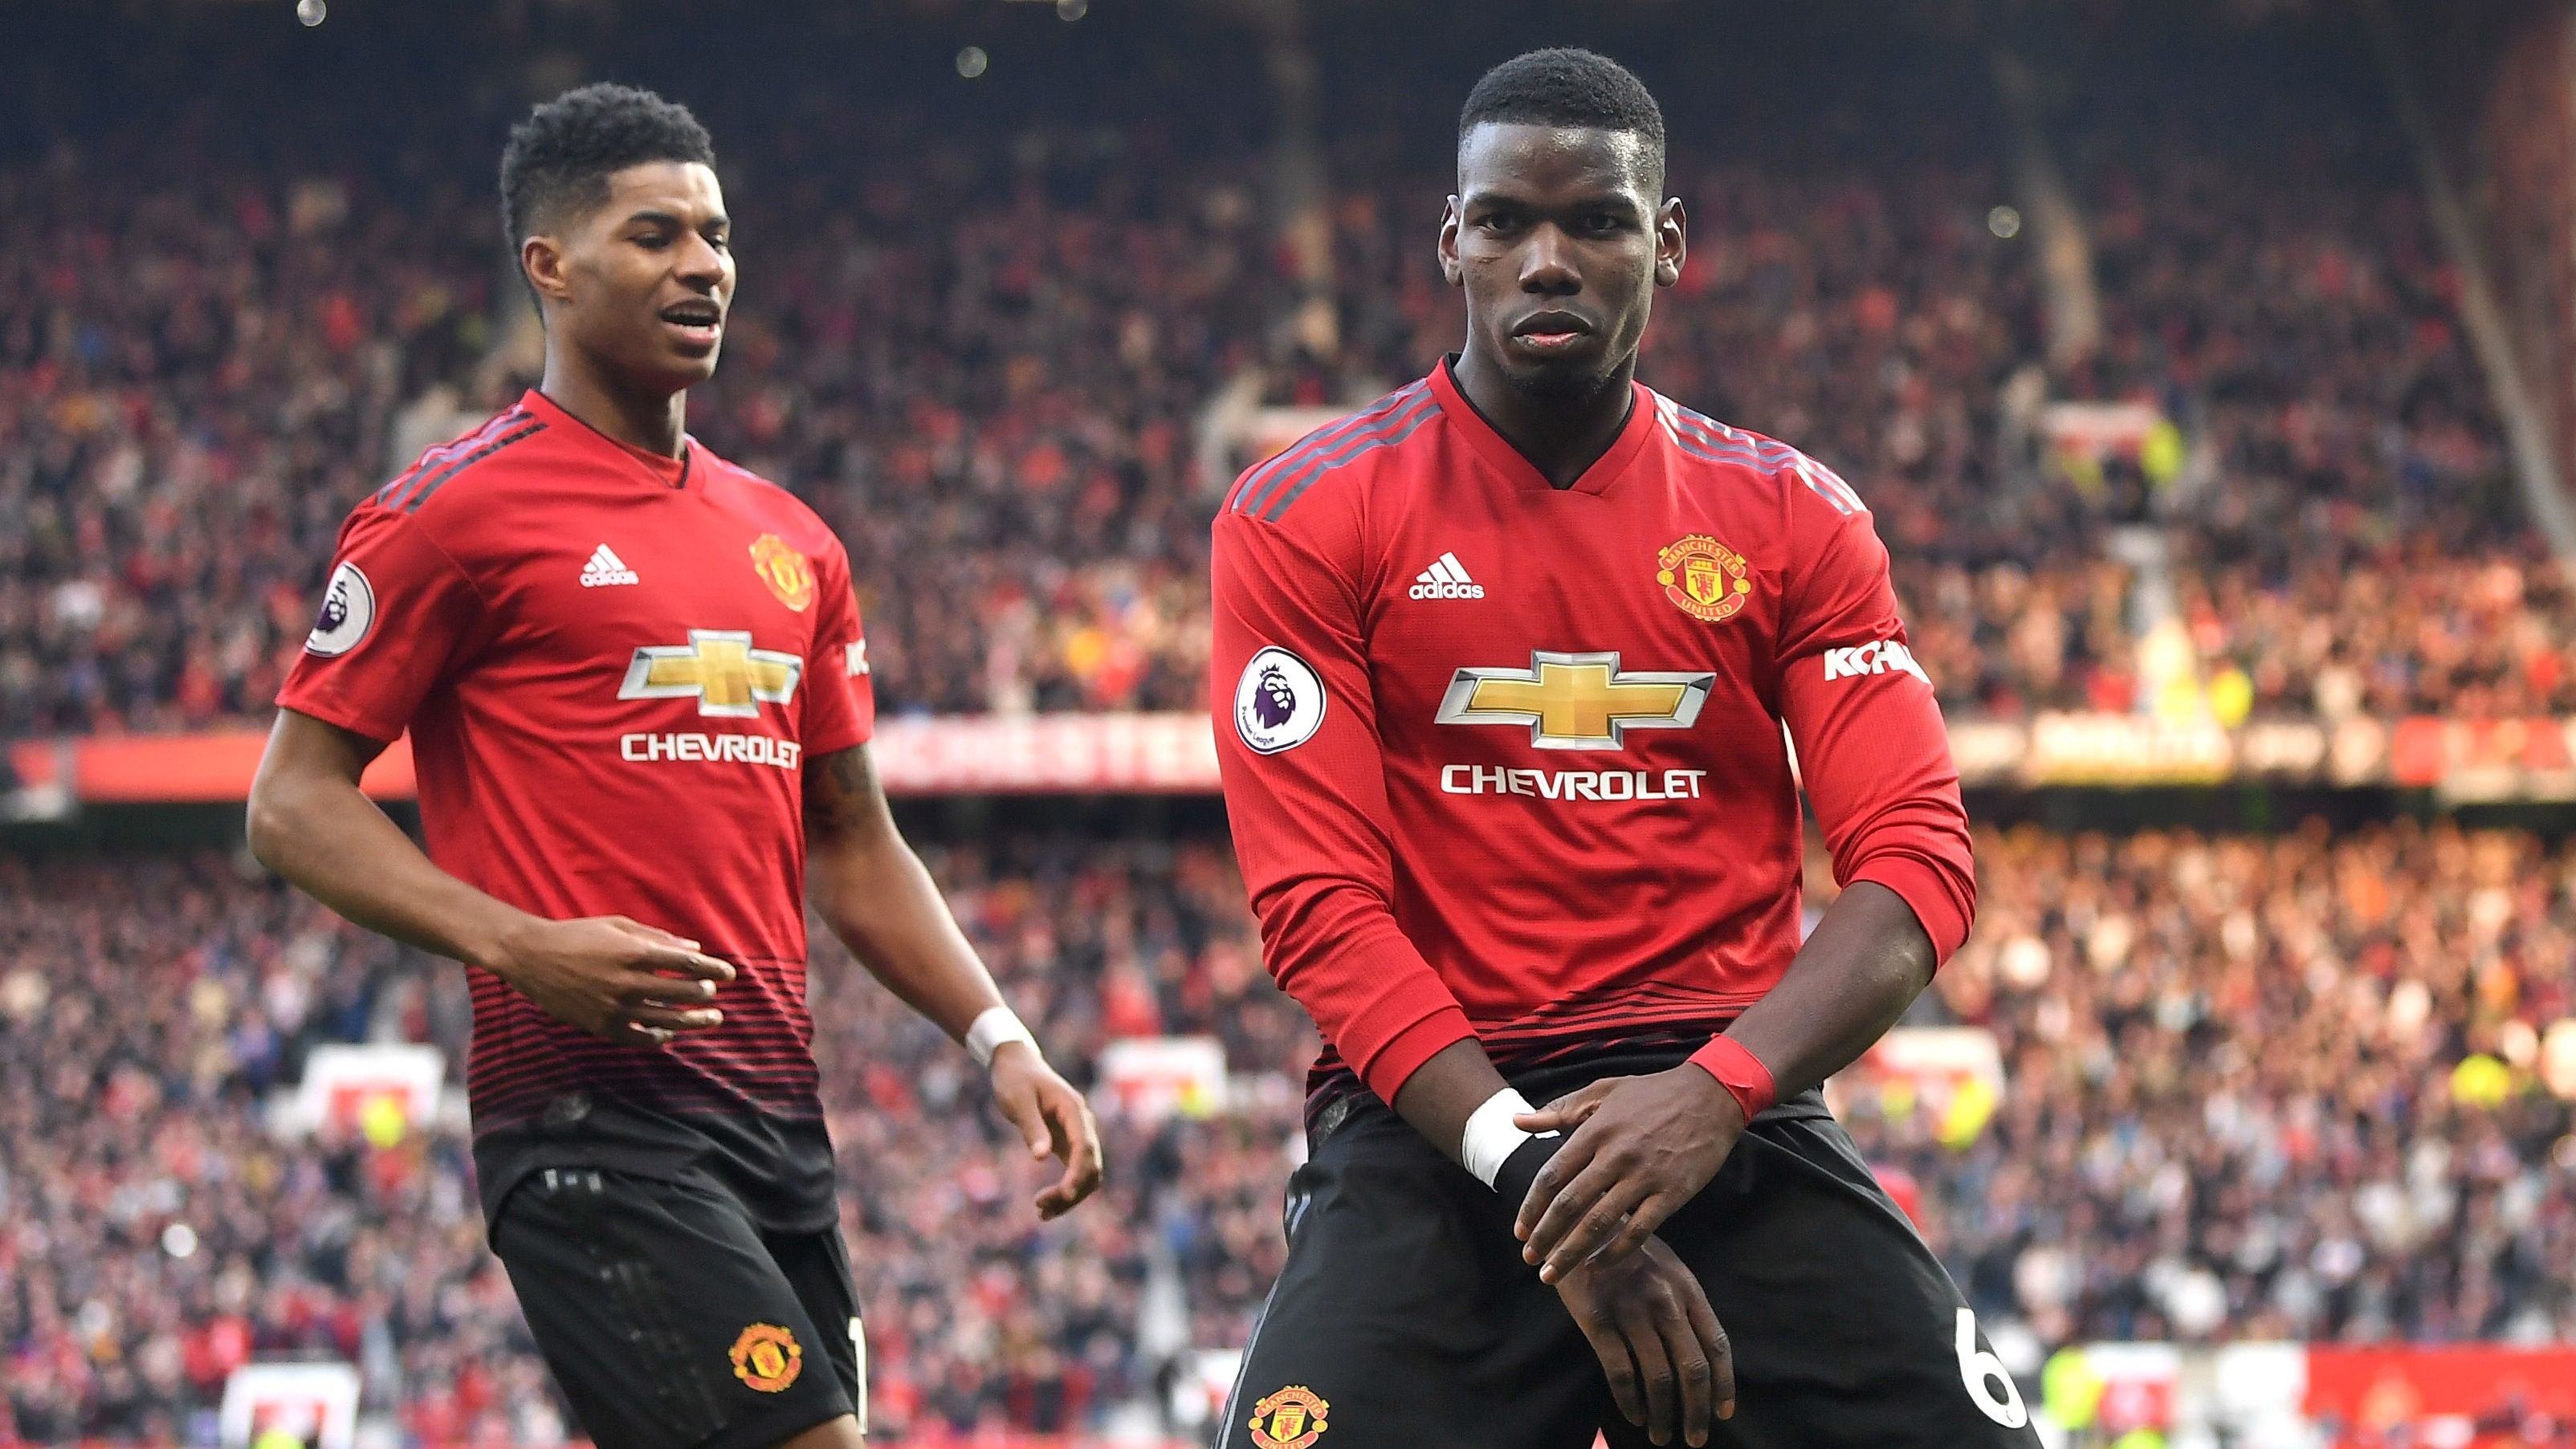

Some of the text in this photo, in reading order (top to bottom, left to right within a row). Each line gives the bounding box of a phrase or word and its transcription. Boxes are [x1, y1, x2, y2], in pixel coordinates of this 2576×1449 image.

[1665, 541, 1740, 573] MANCHESTER
[579, 570, 639, 588] adidas
[1408, 580, 1485, 599] adidas
[1681, 598, 1733, 616] UNITED
[621, 732, 801, 770] CHEVROLET
[1441, 764, 1708, 801] CHEVROLET
[1954, 1307, 2028, 1429] 6
[1261, 1391, 1323, 1416] MANCHESTER
[1262, 1439, 1305, 1449] UNITED
